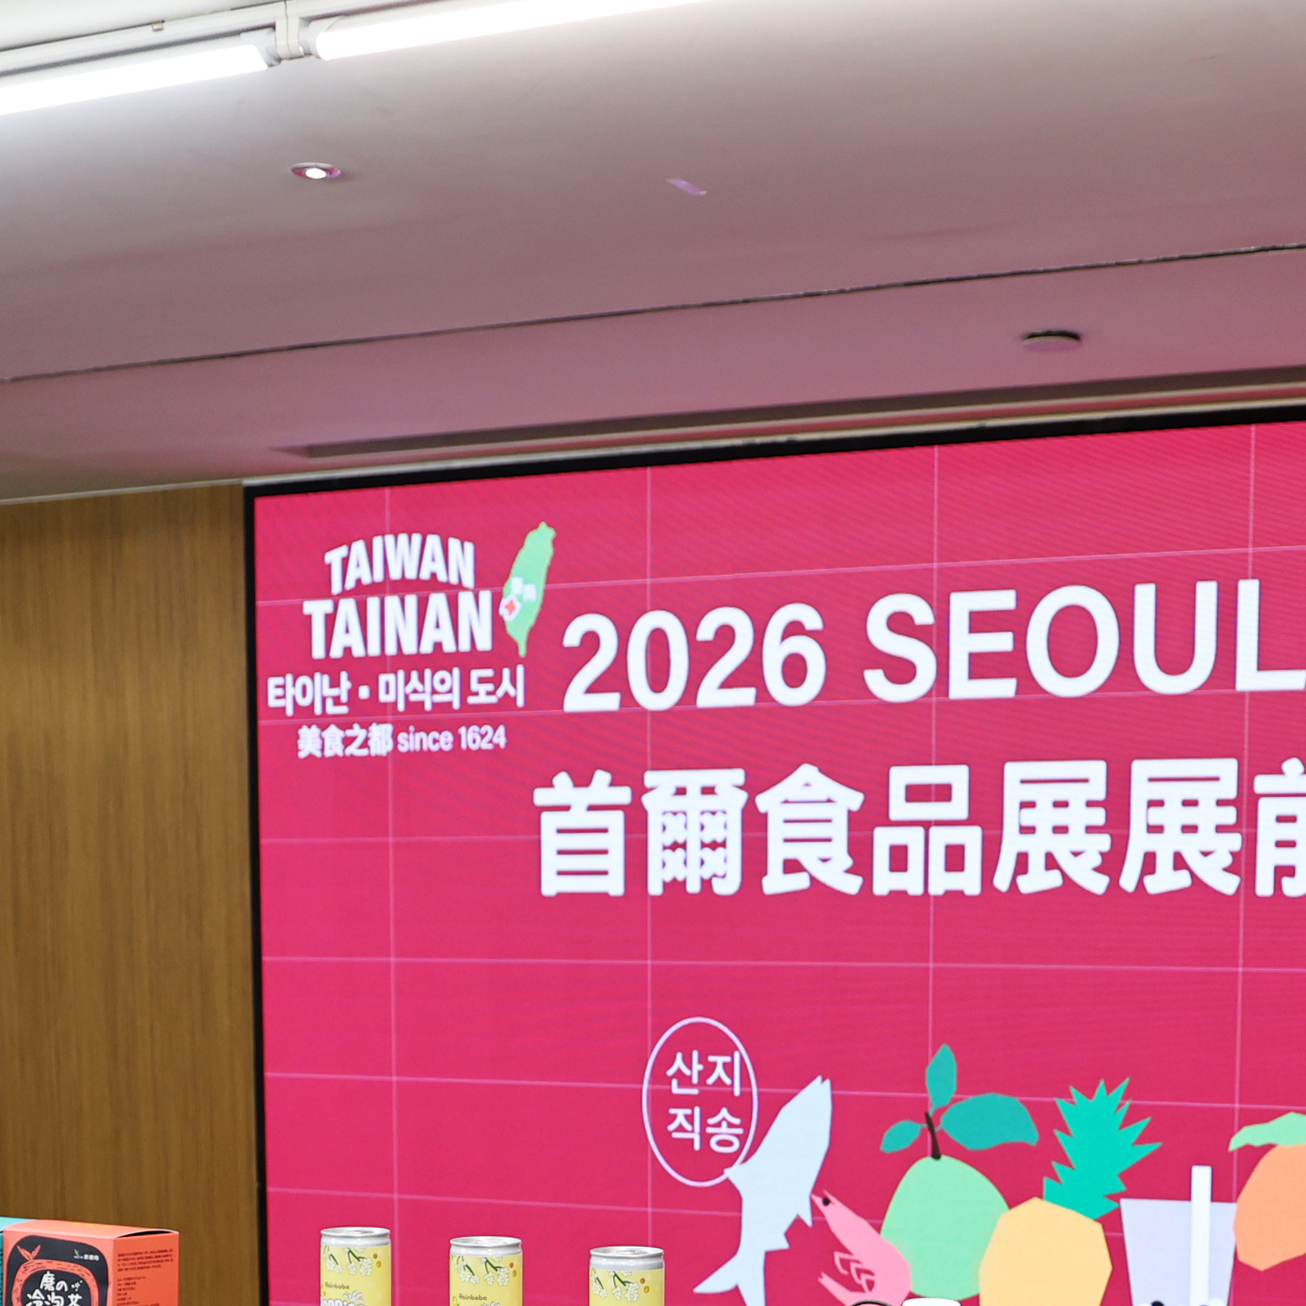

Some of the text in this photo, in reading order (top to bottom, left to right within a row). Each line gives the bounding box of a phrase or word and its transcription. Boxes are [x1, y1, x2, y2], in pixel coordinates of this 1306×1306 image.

[323, 532, 475, 594] TAIWAN
[302, 590, 493, 660] TAINAN
[561, 602, 828, 714] 2026
[267, 664, 526, 717] 타이난 미식의 도시
[297, 722, 394, 759] 美食之都
[397, 724, 507, 753] since 1624
[665, 1049, 743, 1098] 산지
[666, 1104, 747, 1155] 직송
